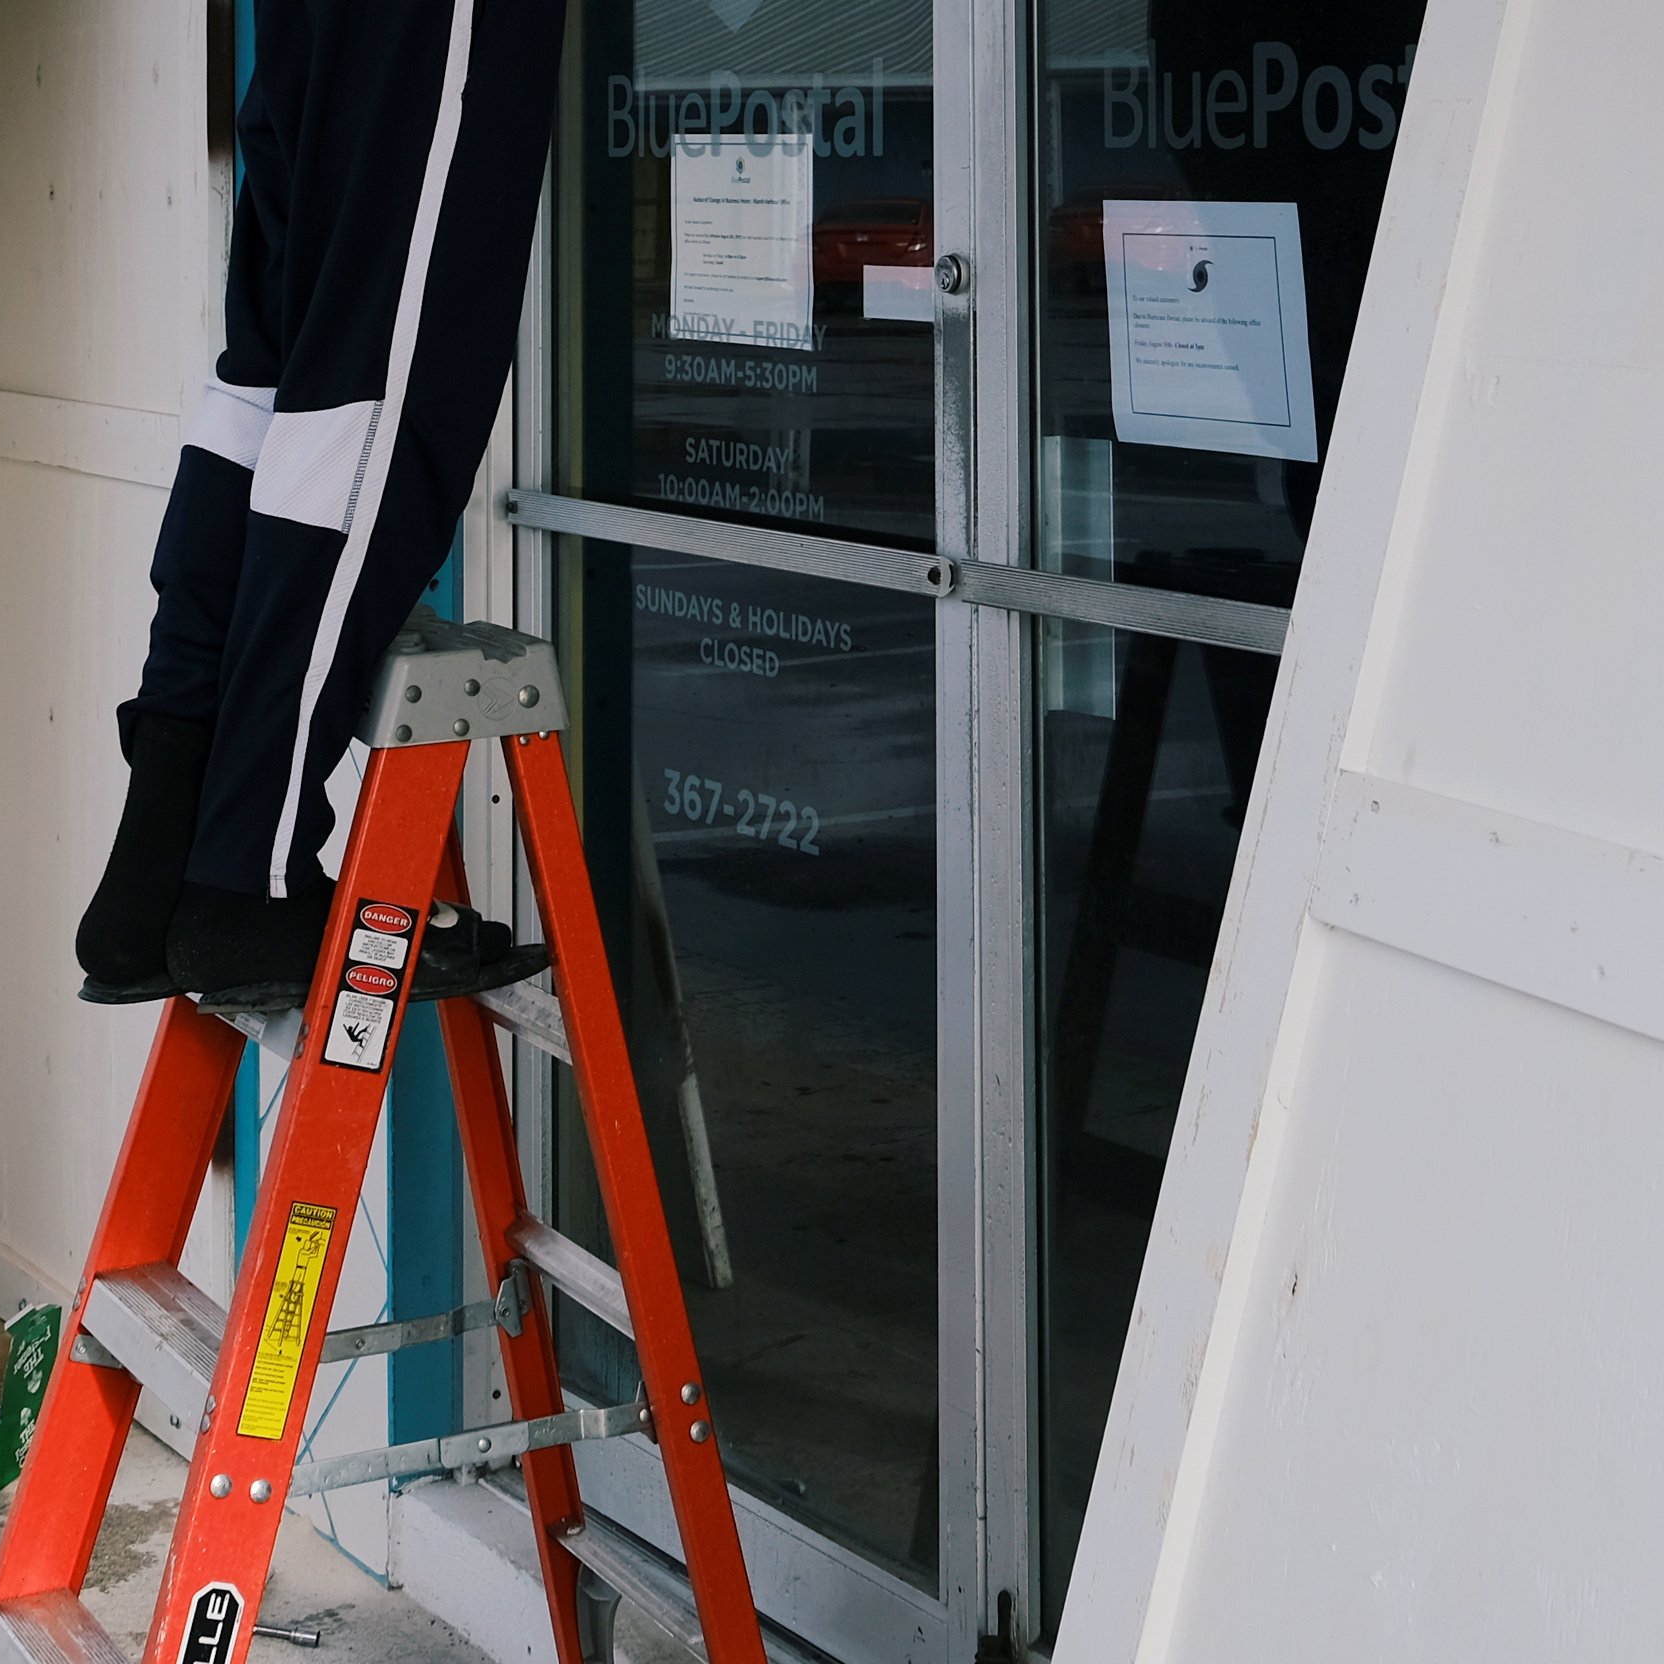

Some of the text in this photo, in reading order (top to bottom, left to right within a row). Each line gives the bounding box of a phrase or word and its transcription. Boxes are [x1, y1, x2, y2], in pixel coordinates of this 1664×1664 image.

[607, 57, 884, 159] BluePostal
[651, 313, 735, 344] MONDAY
[753, 319, 827, 352] FRIDAY
[664, 353, 817, 393] 9:30AM-5:30PM
[685, 437, 789, 475] SATURDAY
[658, 473, 825, 522] 10:00AM-2:00PM
[636, 583, 852, 652] SUNDAYS & HOLIDAYS
[700, 638, 779, 678] CLOSED
[663, 768, 820, 856] 367-2722
[364, 910, 408, 927] DANGER
[349, 970, 395, 988] PELIGRO
[294, 1204, 333, 1219] CAUTION
